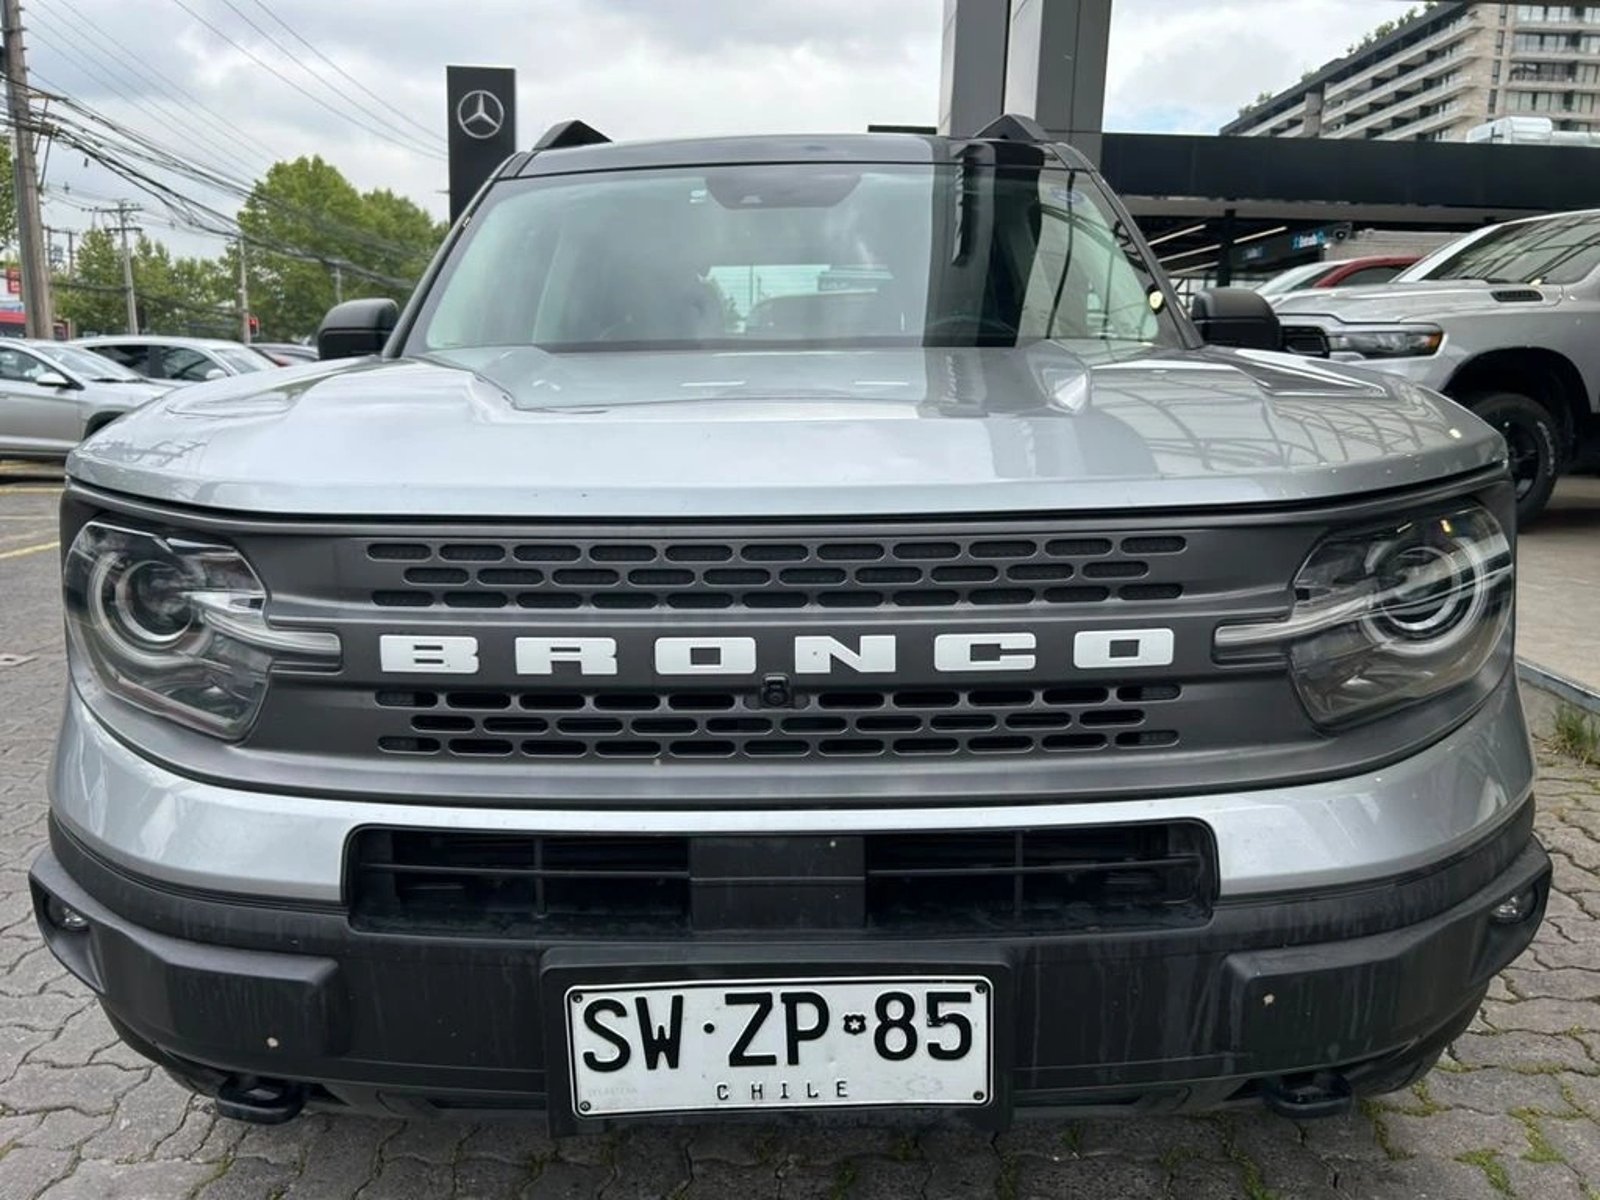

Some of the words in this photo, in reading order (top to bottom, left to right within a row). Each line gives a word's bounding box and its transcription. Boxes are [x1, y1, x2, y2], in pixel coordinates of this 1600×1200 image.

[379, 628, 1175, 675] BRONCO
[873, 991, 973, 1061] 85
[716, 1080, 848, 1101] CHILE
